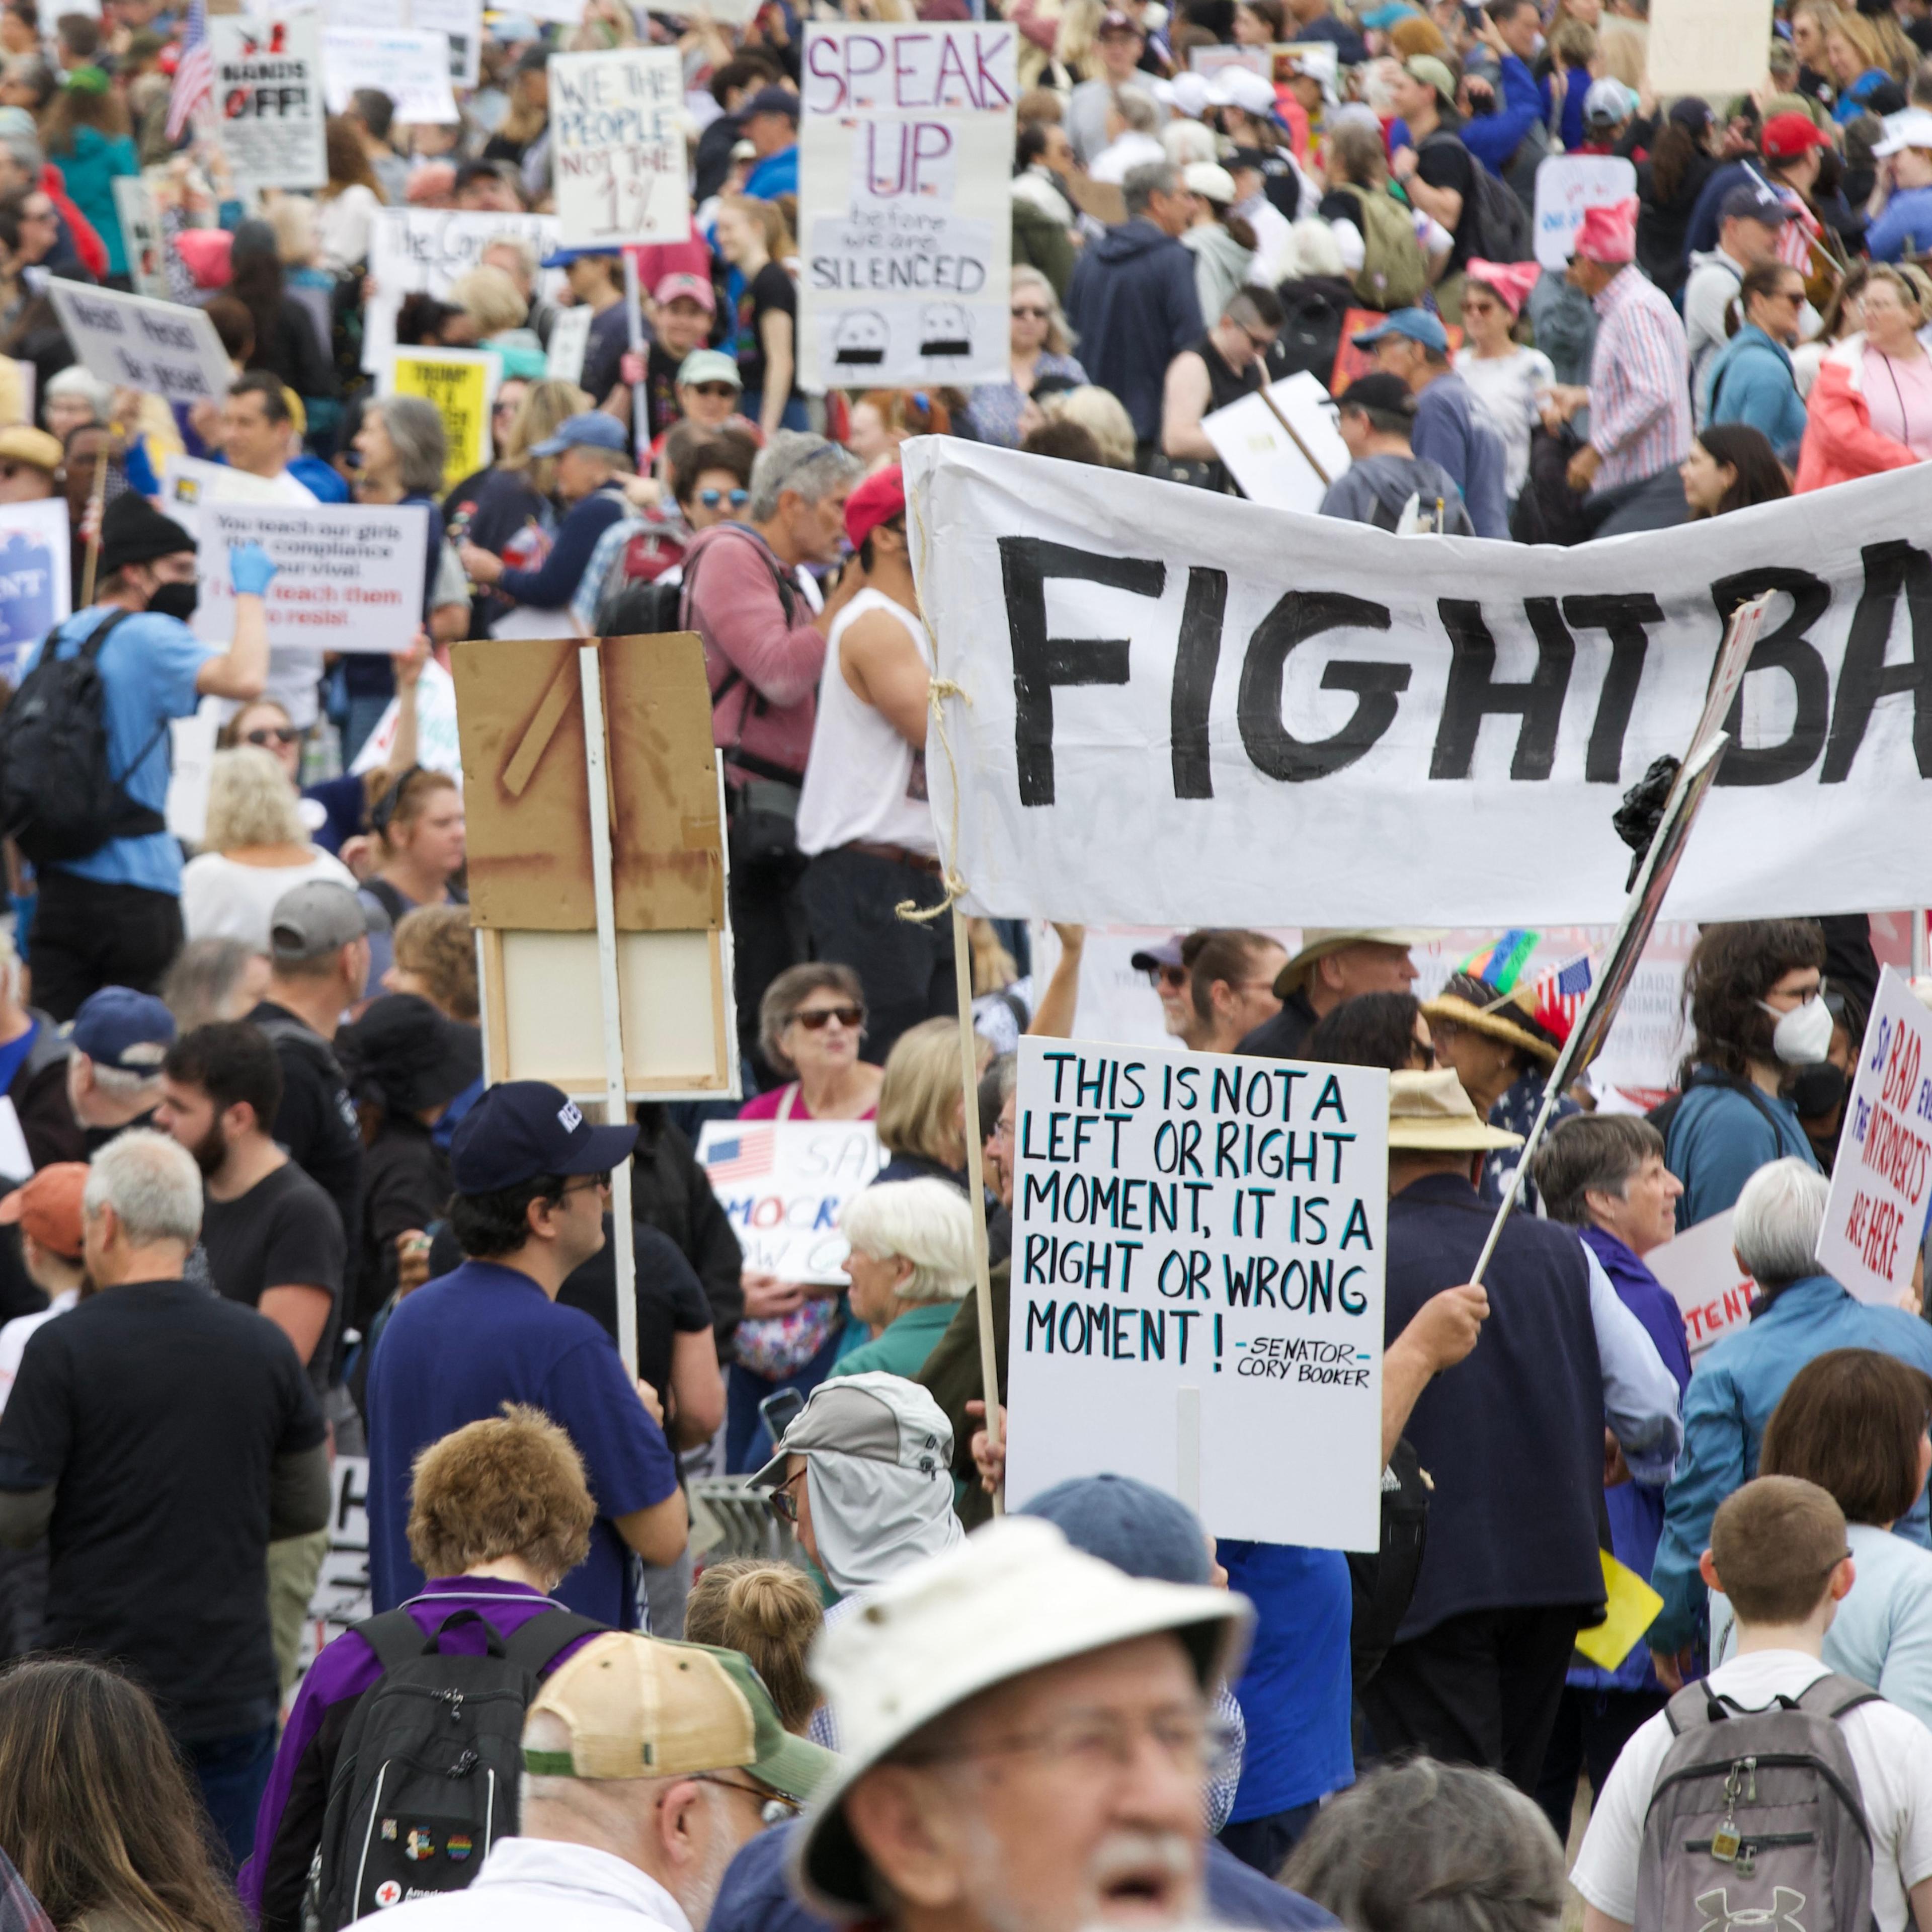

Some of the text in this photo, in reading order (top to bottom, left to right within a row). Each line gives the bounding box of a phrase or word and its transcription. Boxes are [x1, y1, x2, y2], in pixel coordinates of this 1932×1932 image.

[554, 61, 679, 111] WE THE
[809, 31, 1012, 114] SPEAK
[558, 105, 676, 146] PEOPLE
[560, 146, 678, 177] NOT THE
[867, 120, 953, 198] UP
[592, 174, 657, 237] 1%
[850, 202, 947, 231] before
[812, 253, 986, 295] SILENCED
[997, 535, 1666, 807] FIGHT
[1043, 1052, 1348, 1123] THIS IS NOT A
[1871, 1014, 1892, 1073] SO
[1882, 1017, 1921, 1115] BAD
[1022, 1110, 1357, 1184] LEFT OR RIGHT
[1862, 1099, 1931, 1206] INTROVERTS
[1023, 1170, 1374, 1251] MOMENT, IT IS A
[1845, 1189, 1904, 1282] ARE HERE
[1023, 1233, 1369, 1316] RIGHT OR WRONG
[1237, 1357, 1370, 1389] CORY BOOKER
